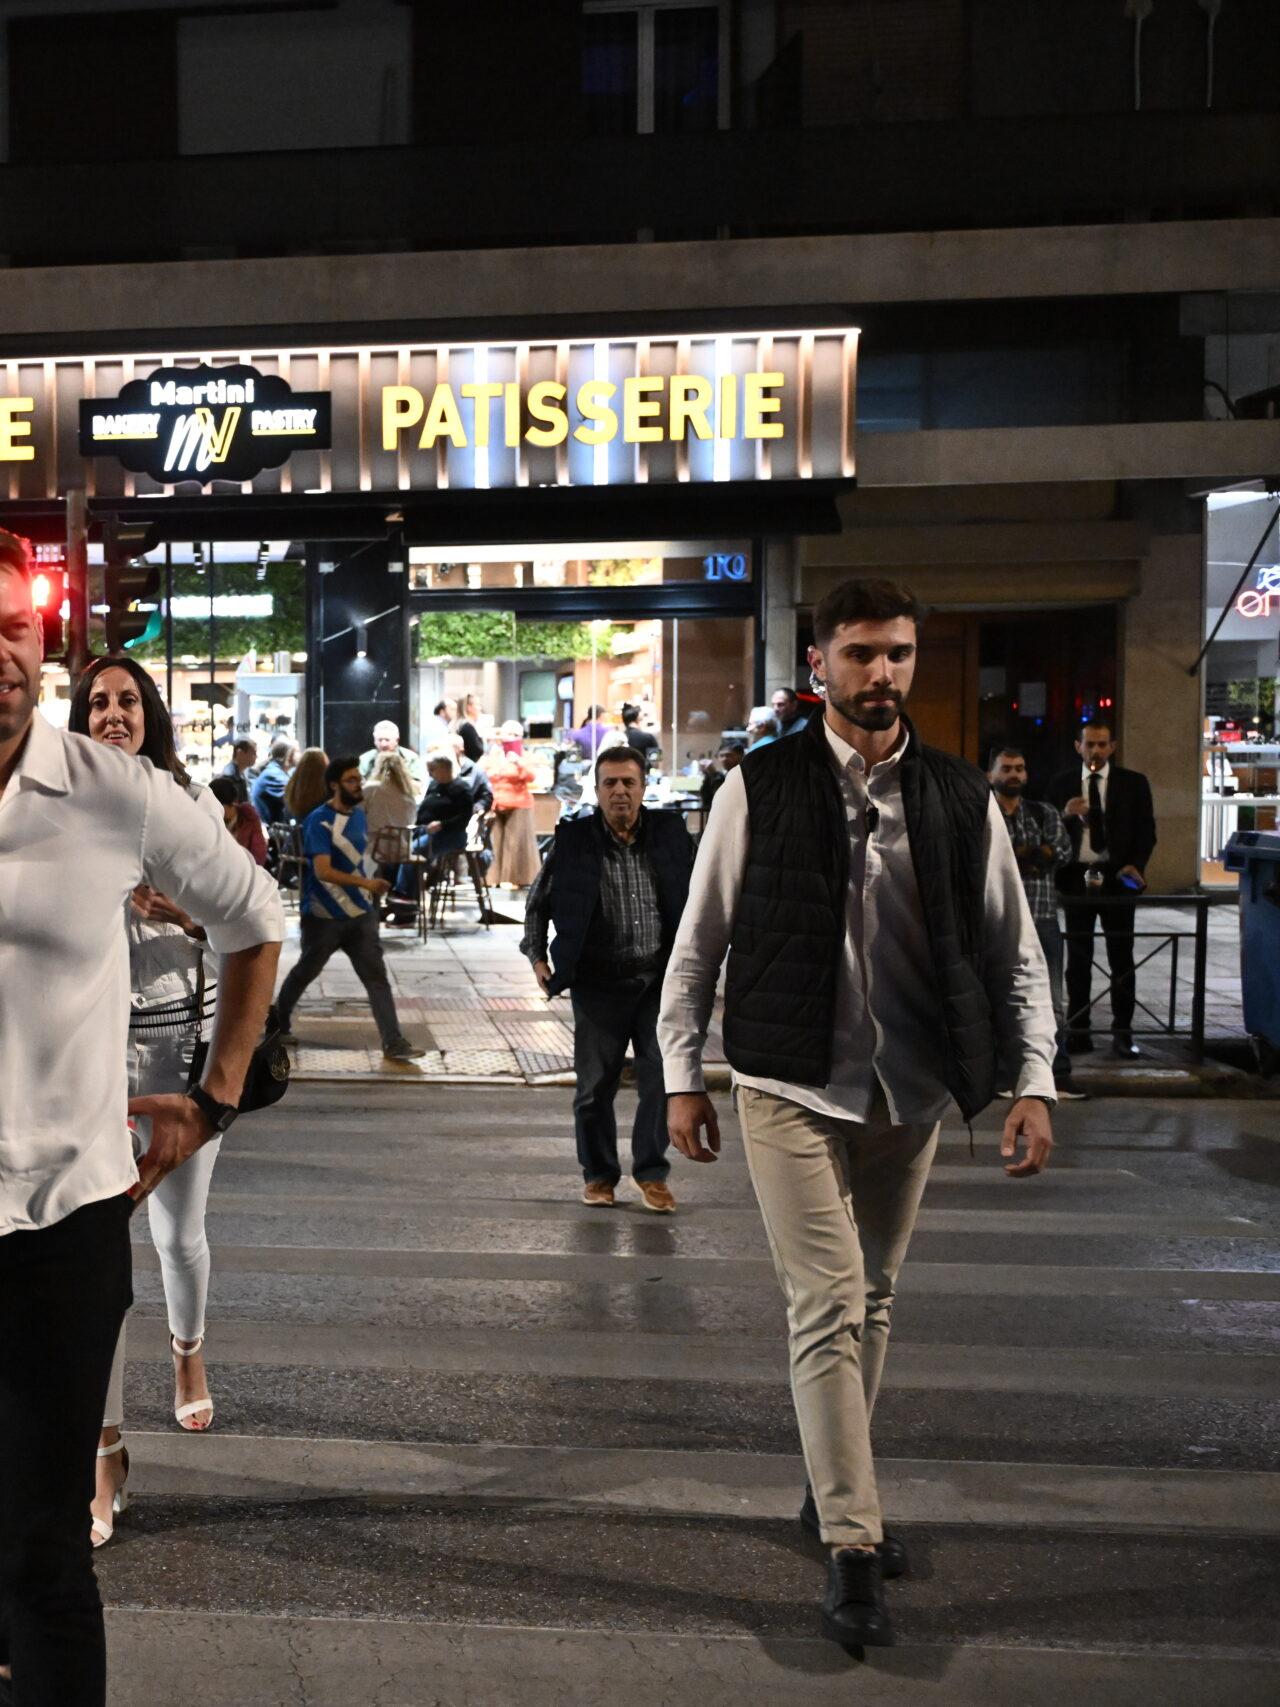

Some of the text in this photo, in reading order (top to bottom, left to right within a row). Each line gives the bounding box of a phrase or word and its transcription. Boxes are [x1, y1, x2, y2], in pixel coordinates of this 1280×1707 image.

[150, 379, 255, 406] Martini
[252, 409, 317, 430] PASTRY
[382, 372, 785, 450] PATISSERIE
